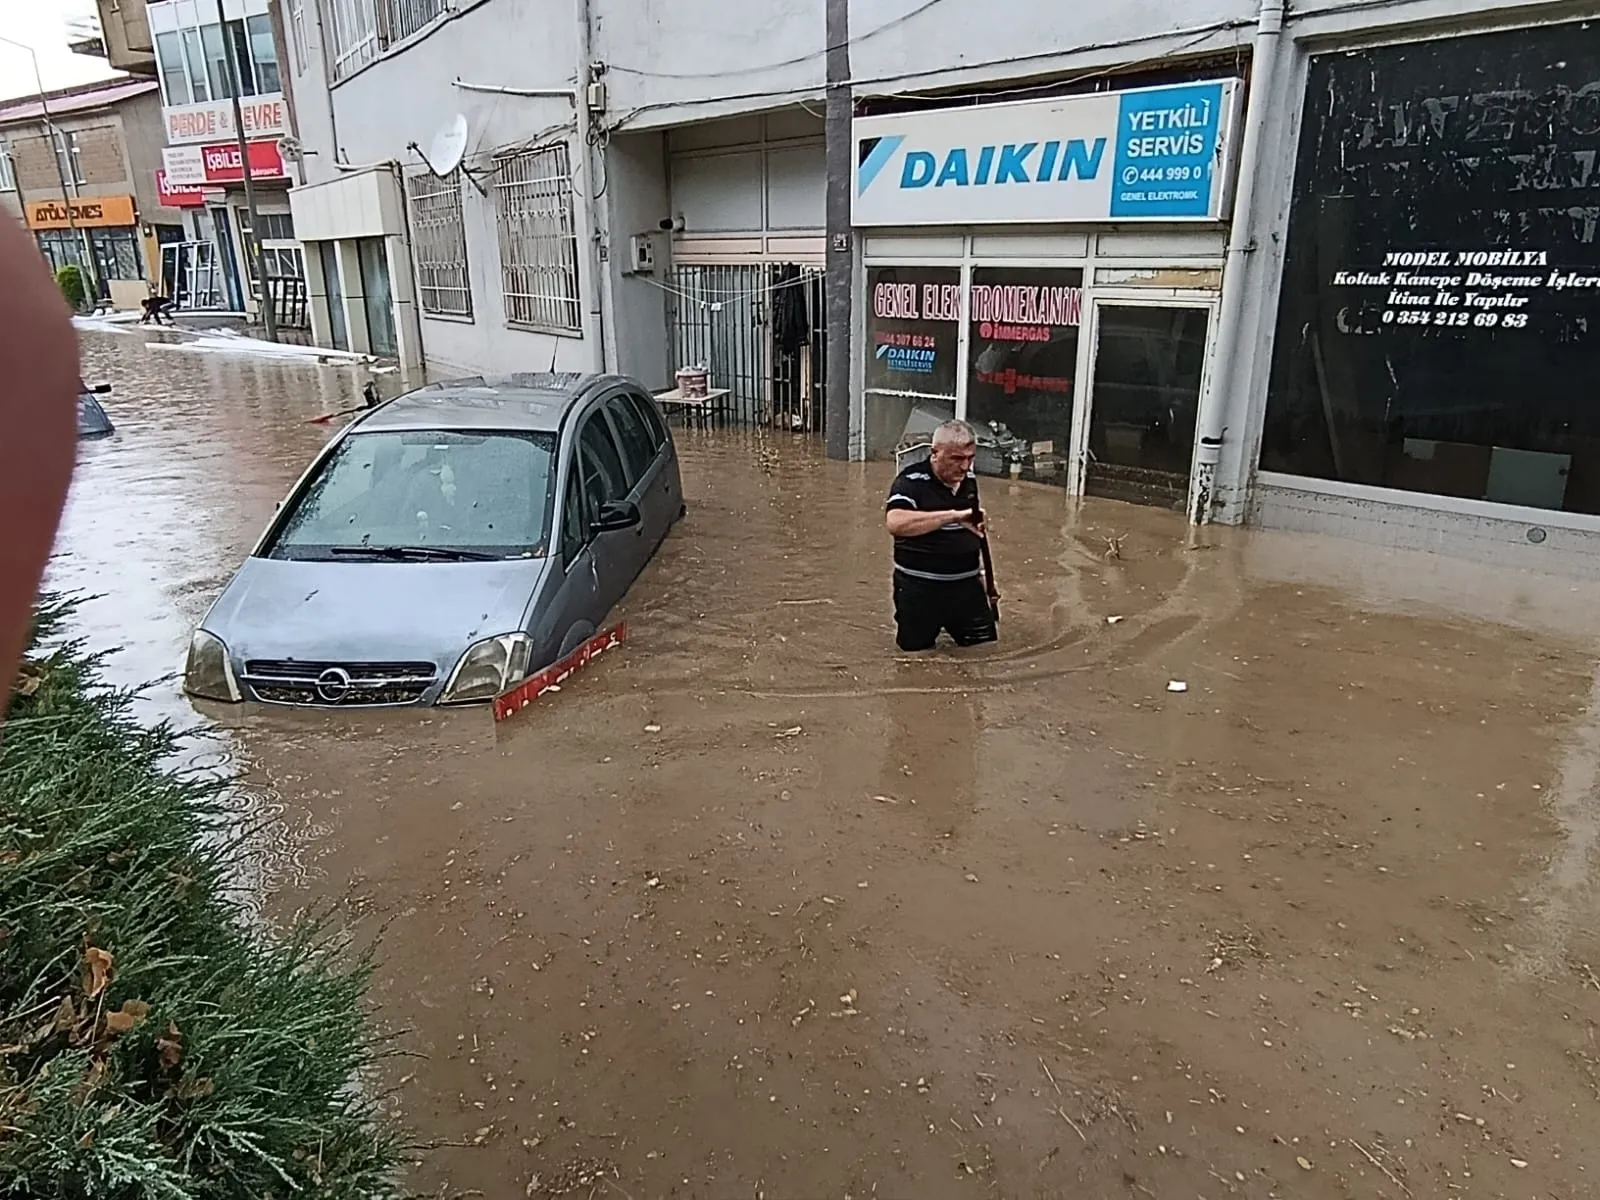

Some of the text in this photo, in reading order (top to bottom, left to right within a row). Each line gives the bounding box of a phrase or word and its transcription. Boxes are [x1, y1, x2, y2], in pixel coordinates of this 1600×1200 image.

[169, 110, 216, 138] PERDE
[233, 102, 283, 132] EVRE
[1128, 98, 1210, 131] YETKİLİ
[1127, 131, 1204, 158] SERVİS
[205, 148, 243, 172] İŞBİLE
[899, 138, 1107, 189] DAIKIN
[1140, 166, 1202, 181] 444 999 0
[1381, 247, 1548, 267] MODEL MOBİLYA
[1333, 271, 1391, 287] Koltuk
[1393, 271, 1461, 289] Kanepe
[1465, 271, 1542, 290] Döşeme
[874, 282, 919, 318] GENEL
[1387, 288, 1528, 311] İtina İle Yapılır
[1382, 310, 1528, 328] 0 354 212 69 83
[887, 348, 936, 362] DAIKIN
